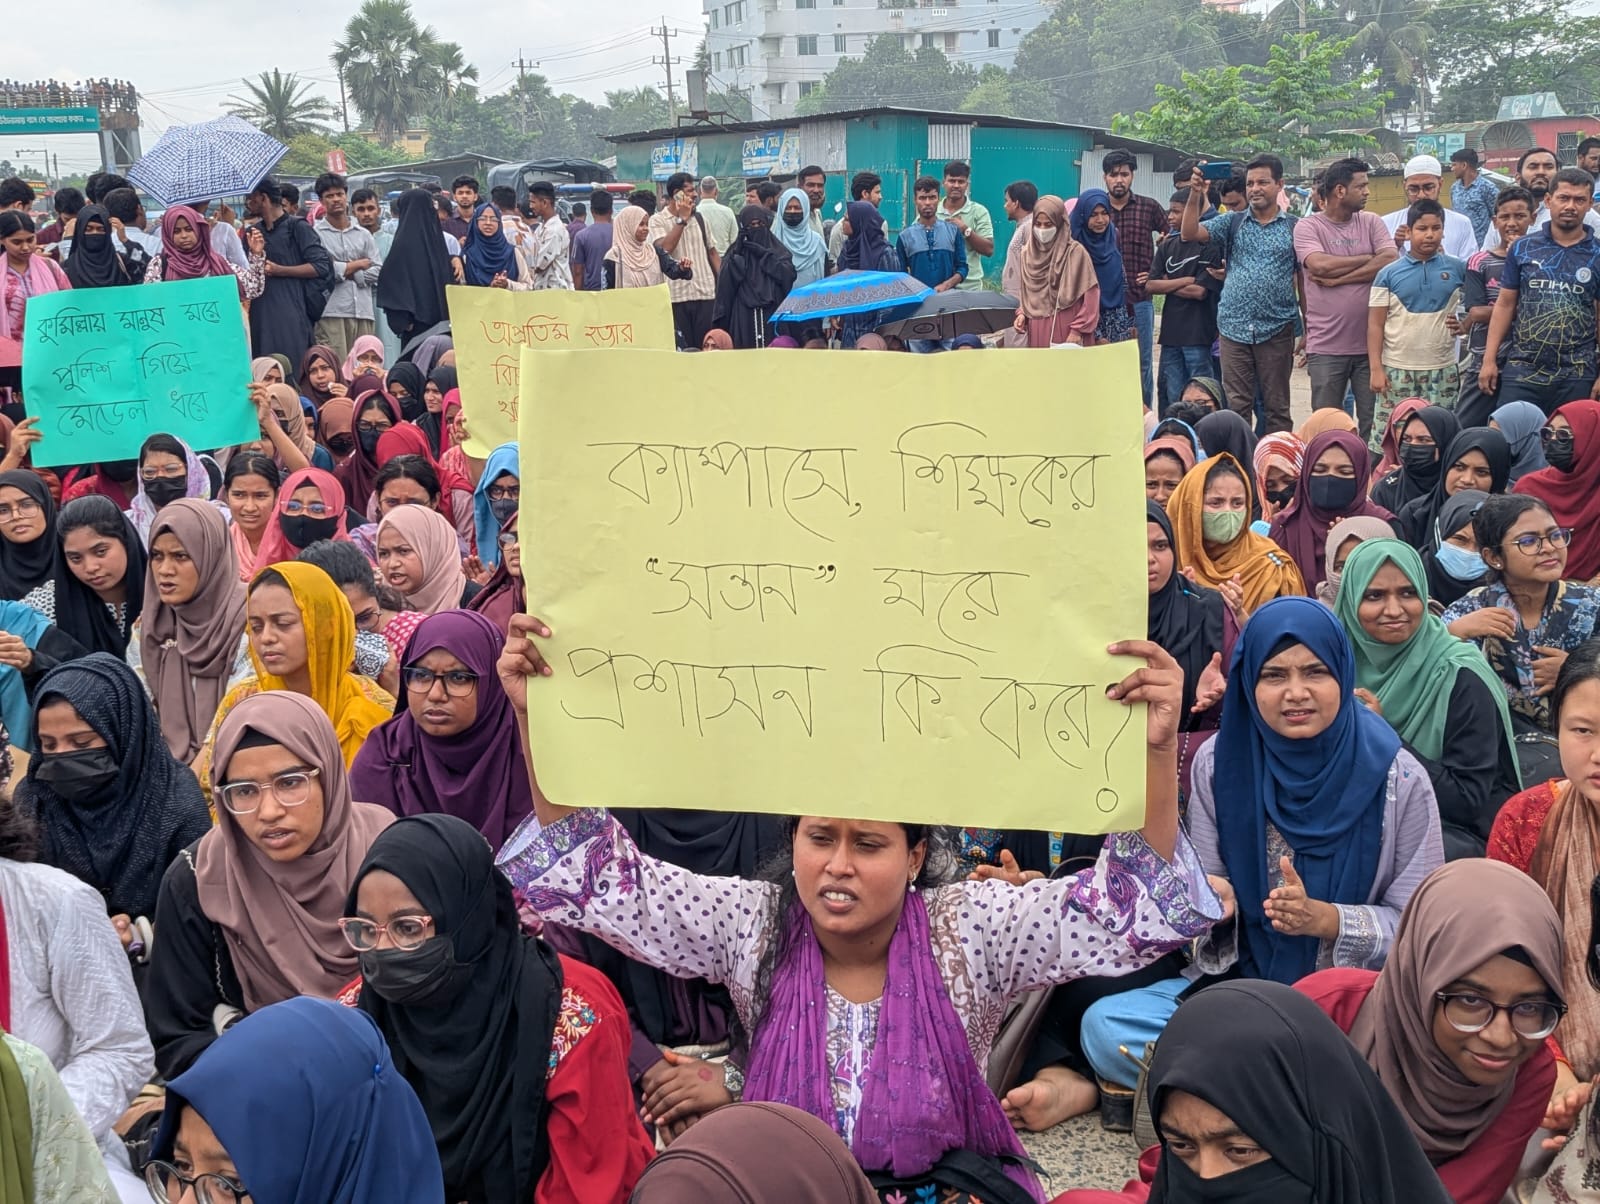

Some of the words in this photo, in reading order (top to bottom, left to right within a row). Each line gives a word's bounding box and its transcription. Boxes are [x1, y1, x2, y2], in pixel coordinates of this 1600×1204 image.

[1528, 278, 1585, 295] ETIHAD
[114, 307, 166, 332] মানুষ
[179, 300, 220, 324] মরে
[584, 322, 634, 347] হত্যার
[52, 347, 117, 394] পুলিশ
[169, 390, 209, 422] ধরে
[892, 422, 1111, 528] শিক্ষকের
[873, 568, 1030, 653] মরে
[560, 648, 826, 738] প্রশাসন
[863, 645, 979, 742] কি
